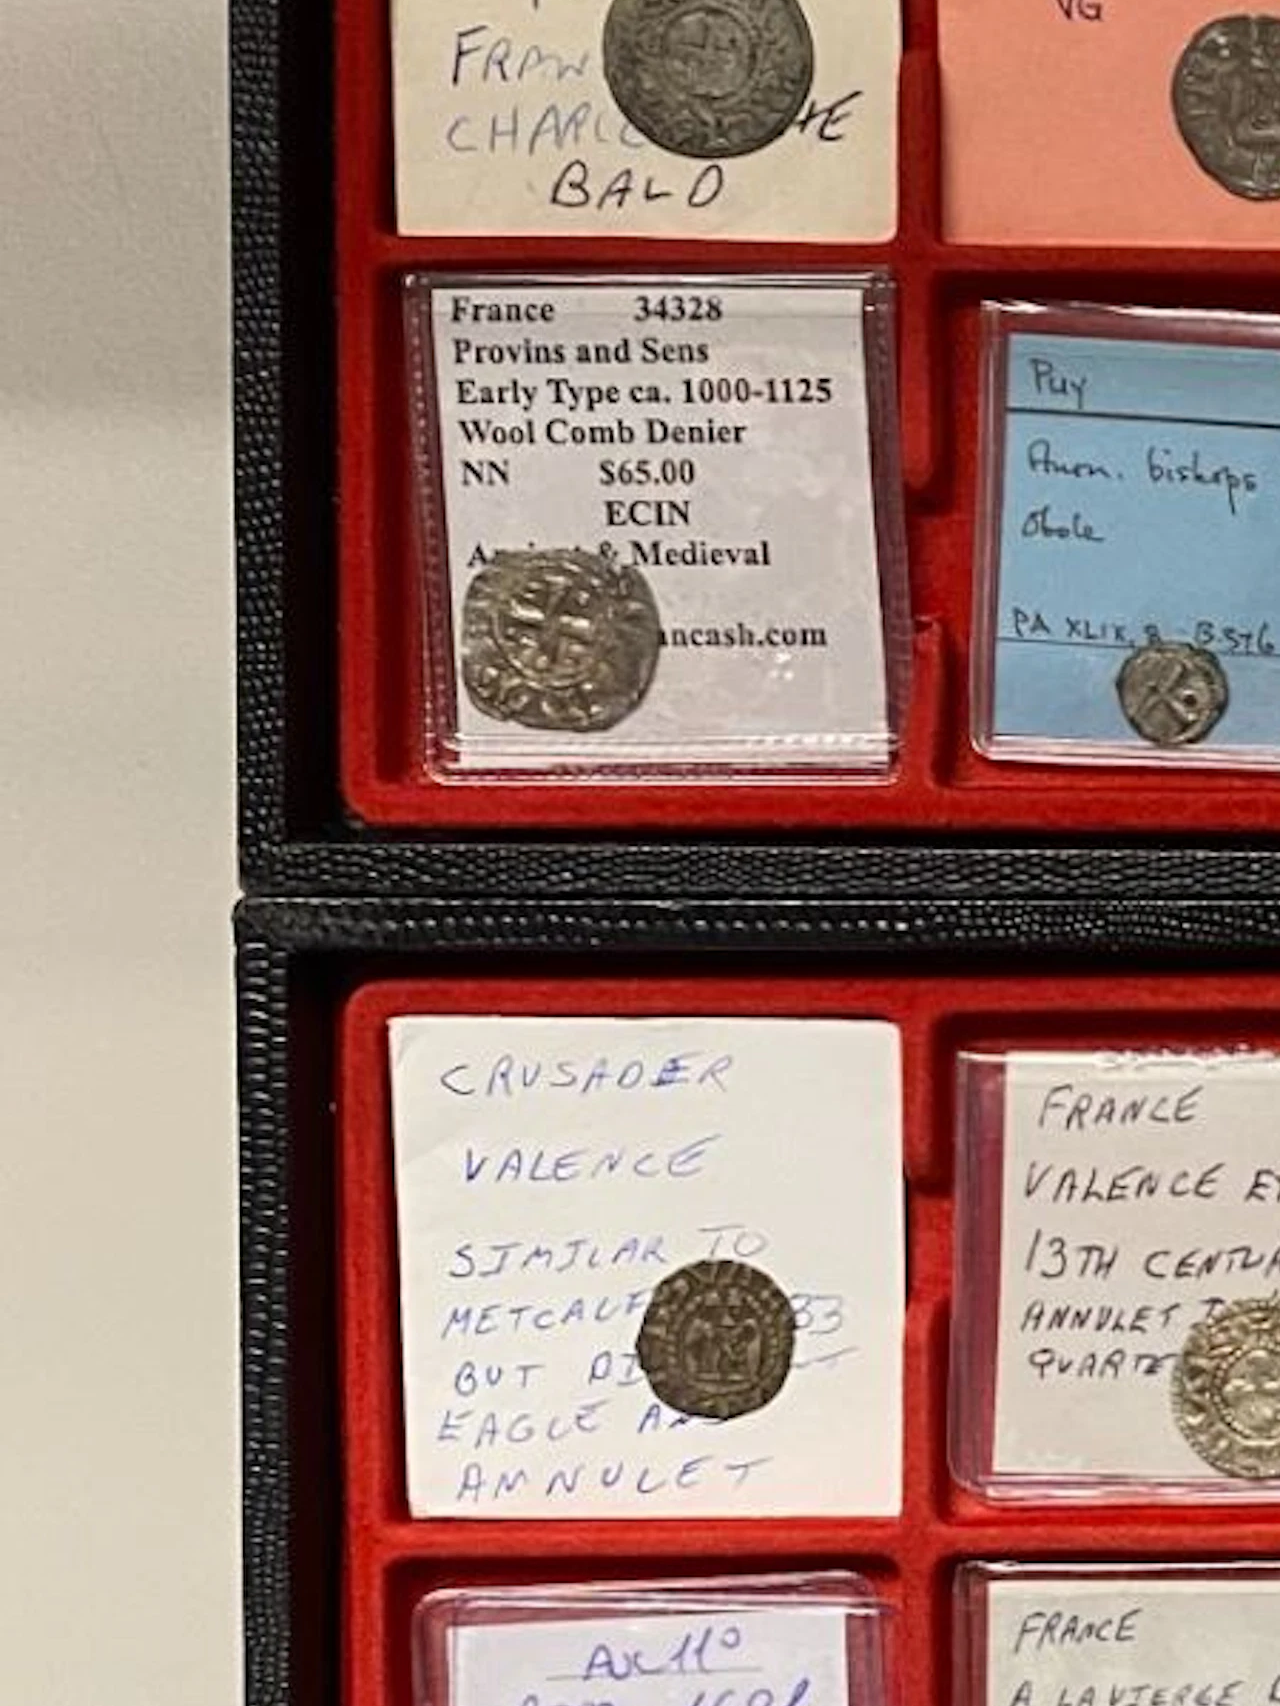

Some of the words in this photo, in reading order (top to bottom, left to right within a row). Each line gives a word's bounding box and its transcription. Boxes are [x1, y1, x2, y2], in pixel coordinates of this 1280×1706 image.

[454, 339, 567, 365] Provins
[576, 339, 631, 364] and
[641, 339, 710, 364] Sens
[457, 379, 539, 410] Early
[546, 379, 621, 411] Type
[629, 383, 671, 404] ca.
[681, 378, 833, 404] 1000-1125
[1030, 357, 1088, 409] Puy
[459, 421, 536, 444] Wool
[545, 420, 646, 444] Comb
[646, 420, 747, 444] Denier
[441, 1054, 733, 1097] CRUSADER
[1040, 1084, 1204, 1130] FRANCE
[465, 1134, 723, 1184] VALENCE
[1025, 1161, 1226, 1204] VALENCE
[698, 1225, 768, 1259] TO
[1025, 1229, 1118, 1281] 13TH
[456, 1456, 773, 1502] ANNULET
[1014, 1608, 1143, 1656] FRANCE
